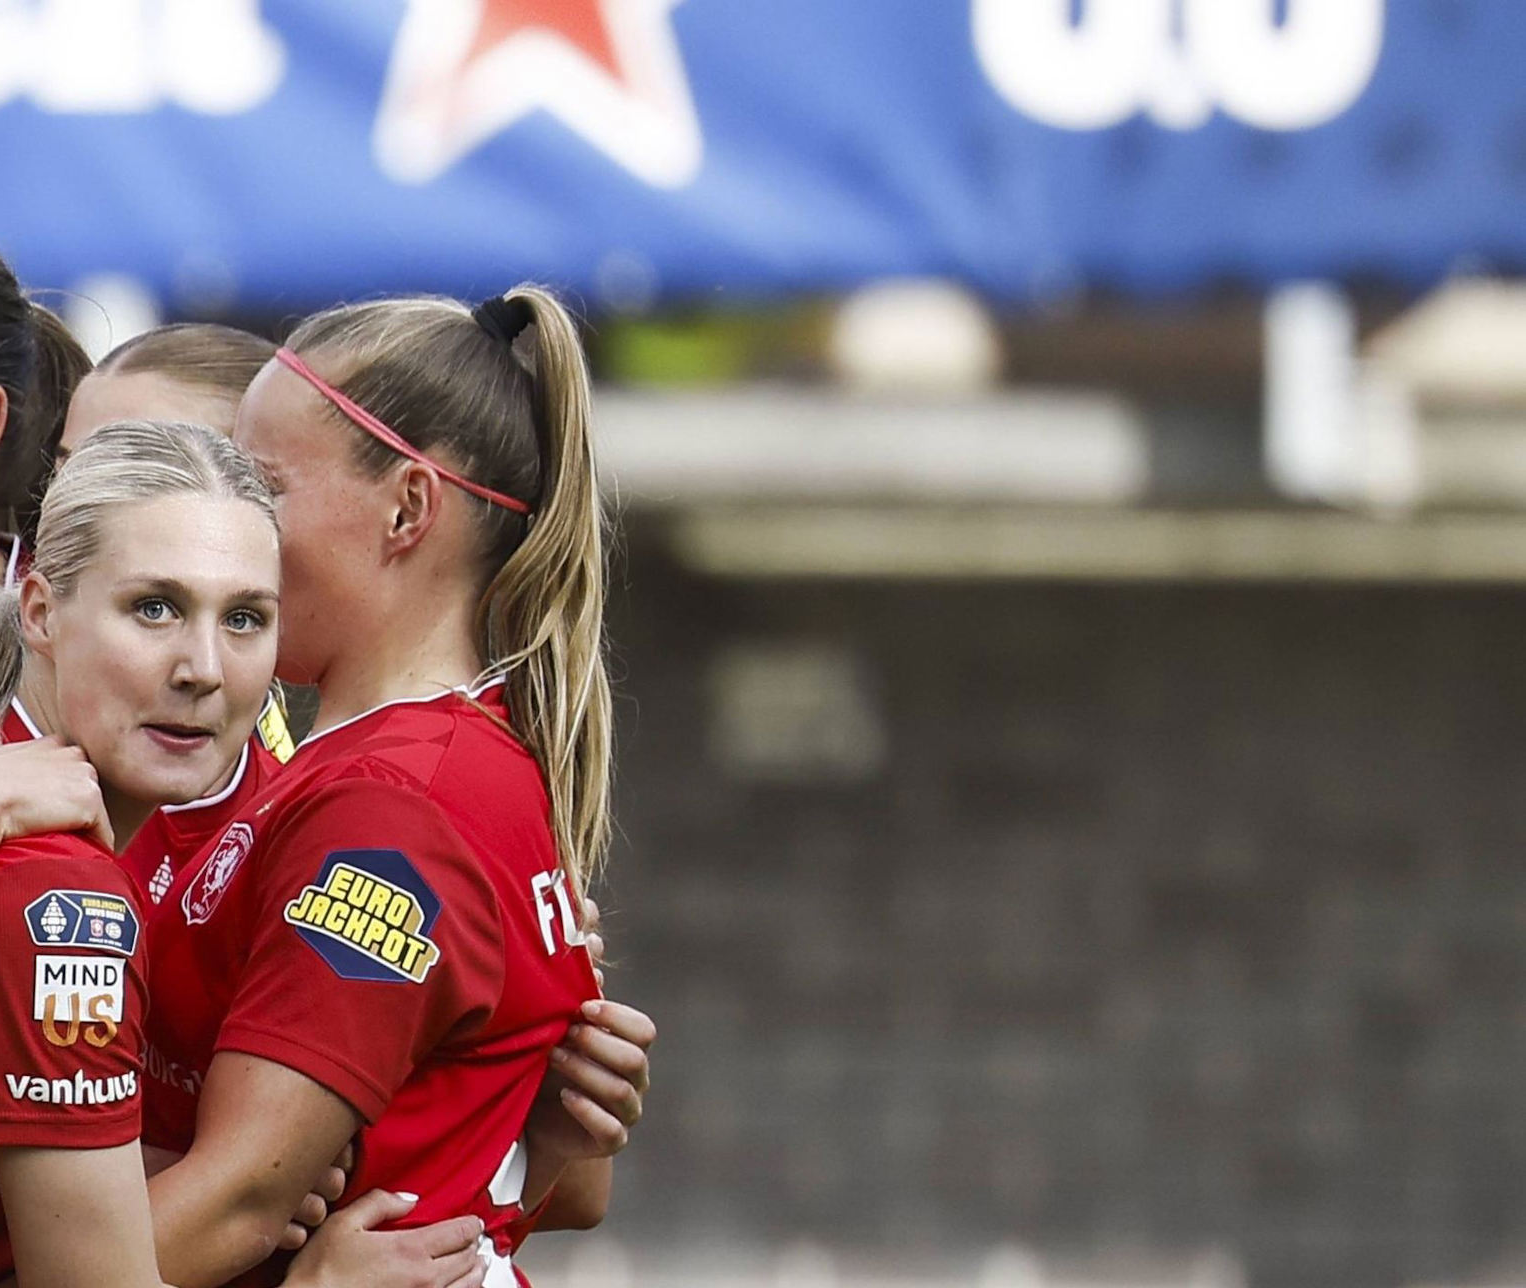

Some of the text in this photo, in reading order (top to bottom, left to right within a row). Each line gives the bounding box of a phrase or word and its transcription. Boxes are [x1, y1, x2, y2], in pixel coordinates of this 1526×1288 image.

[326, 866, 414, 928] EURO
[287, 889, 428, 972] JACKPOT
[43, 962, 119, 987] MIND
[42, 991, 118, 1048] US
[4, 1068, 137, 1105] vanhuus
